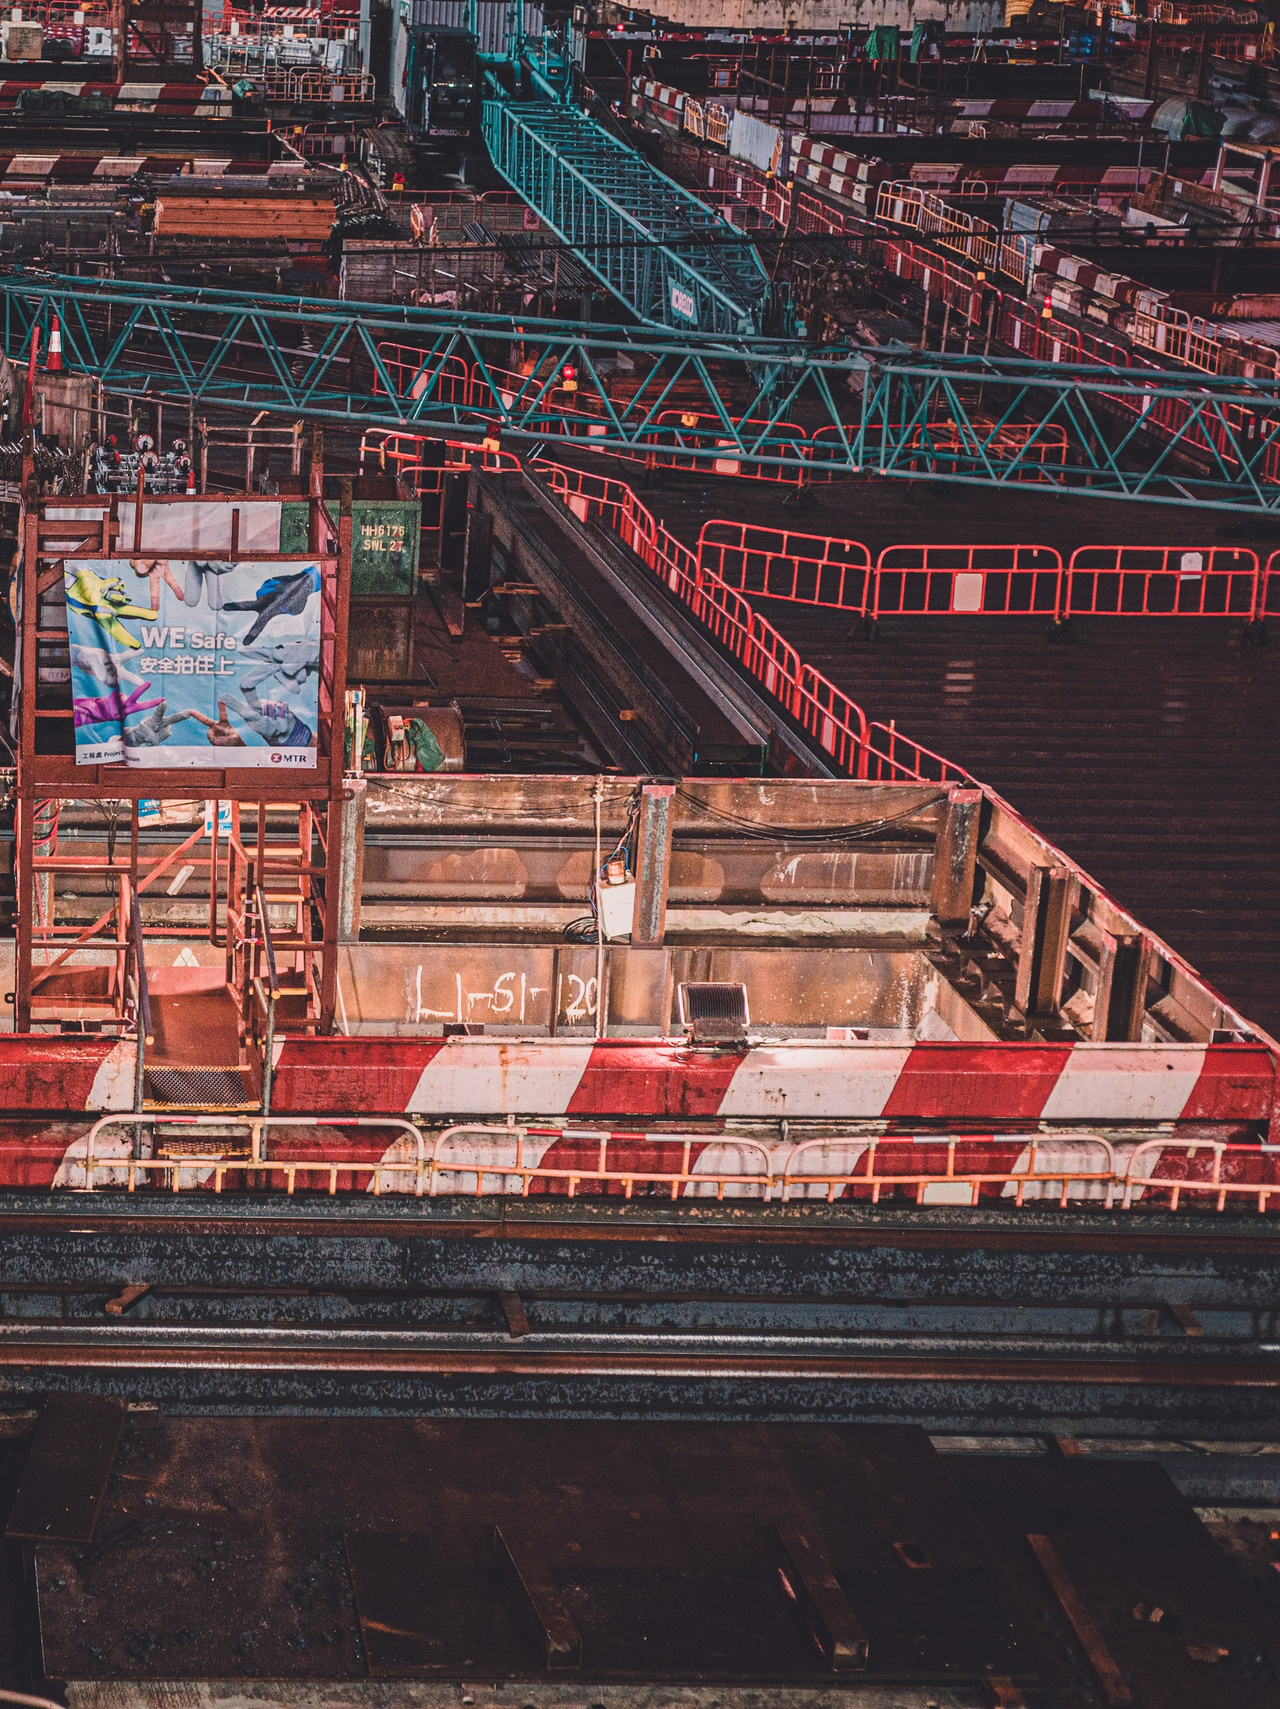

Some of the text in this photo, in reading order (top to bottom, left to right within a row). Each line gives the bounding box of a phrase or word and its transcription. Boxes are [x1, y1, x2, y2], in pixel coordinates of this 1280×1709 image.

[361, 524, 405, 537] HH6176
[363, 539, 404, 552] SWL 2T
[140, 625, 235, 650] WE Safe
[140, 655, 234, 675] 安全拍住上
[283, 754, 307, 763] MTR
